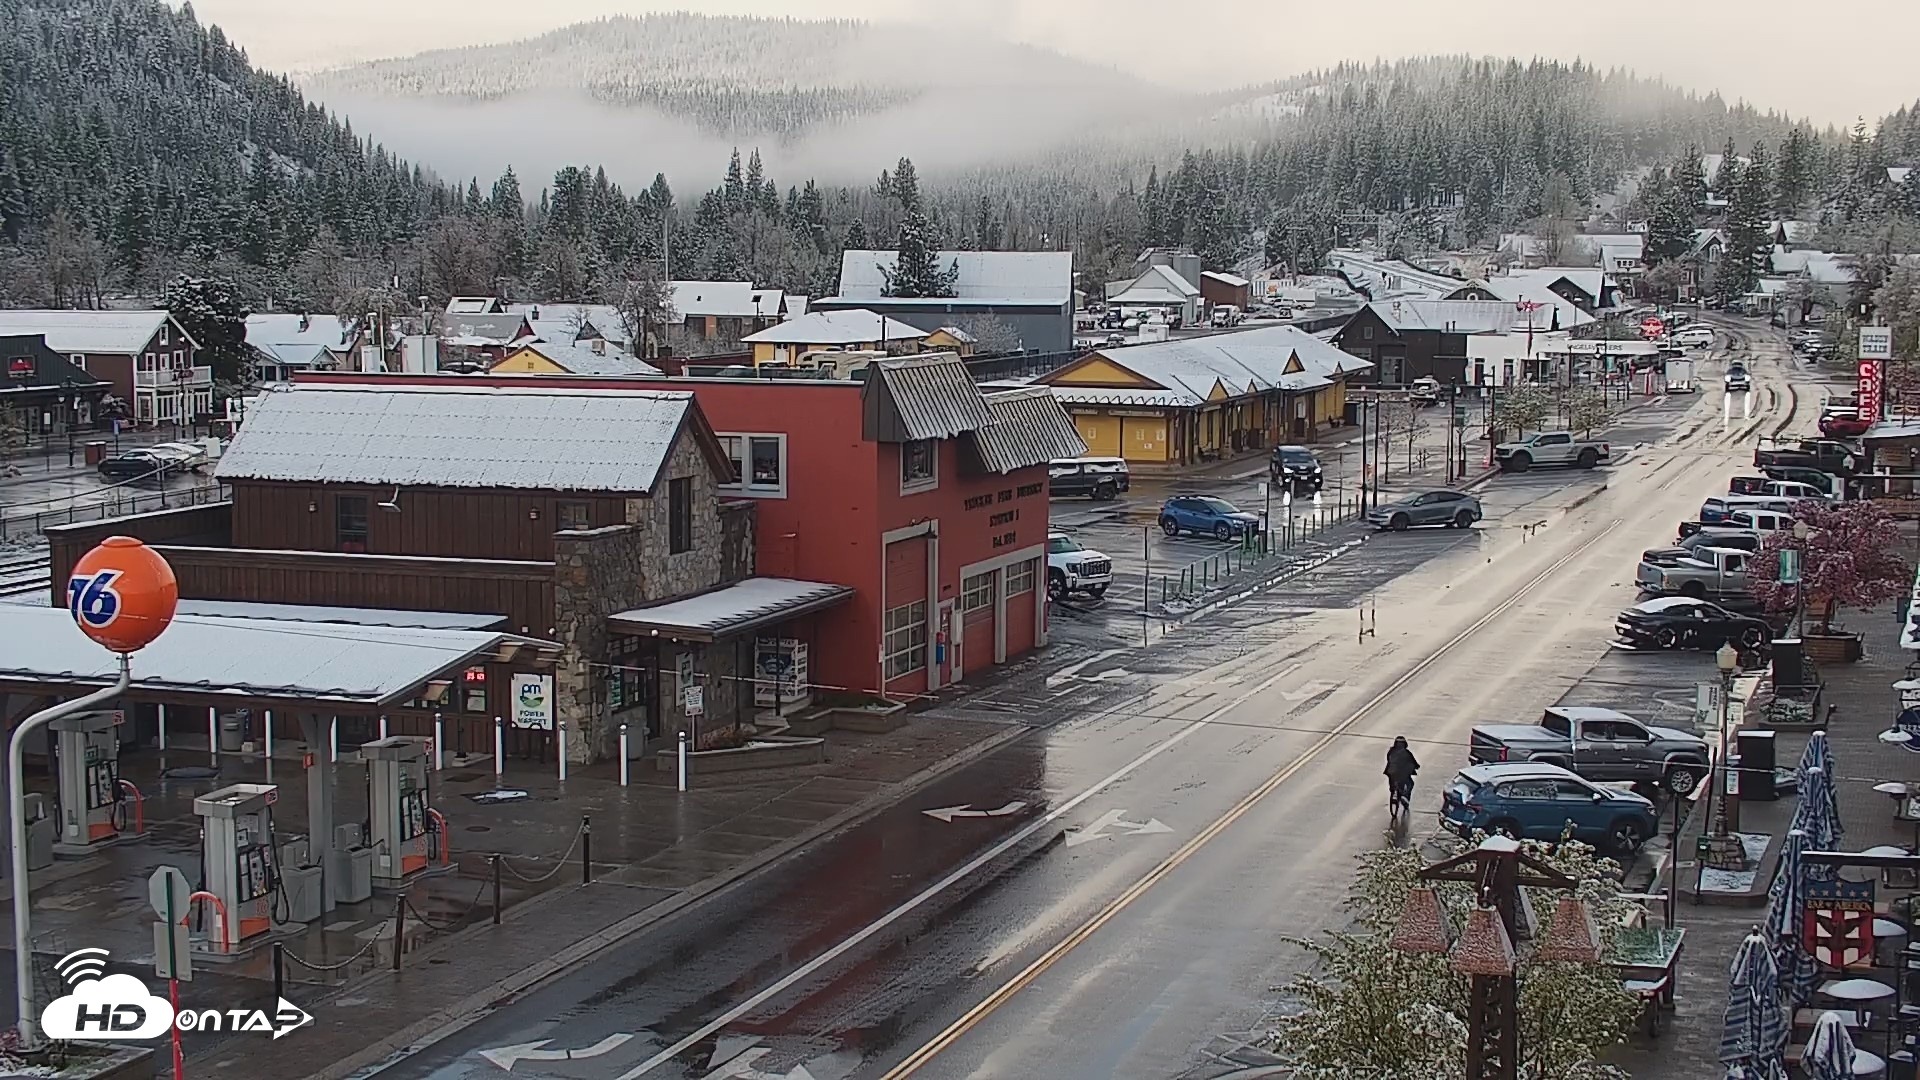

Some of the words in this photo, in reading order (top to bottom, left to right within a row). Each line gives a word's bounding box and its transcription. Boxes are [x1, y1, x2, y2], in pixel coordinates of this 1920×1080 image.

[1859, 363, 1872, 421] CAFE
[67, 569, 124, 628] 76
[519, 710, 545, 718] POWER
[1834, 901, 1872, 911] AMERICA
